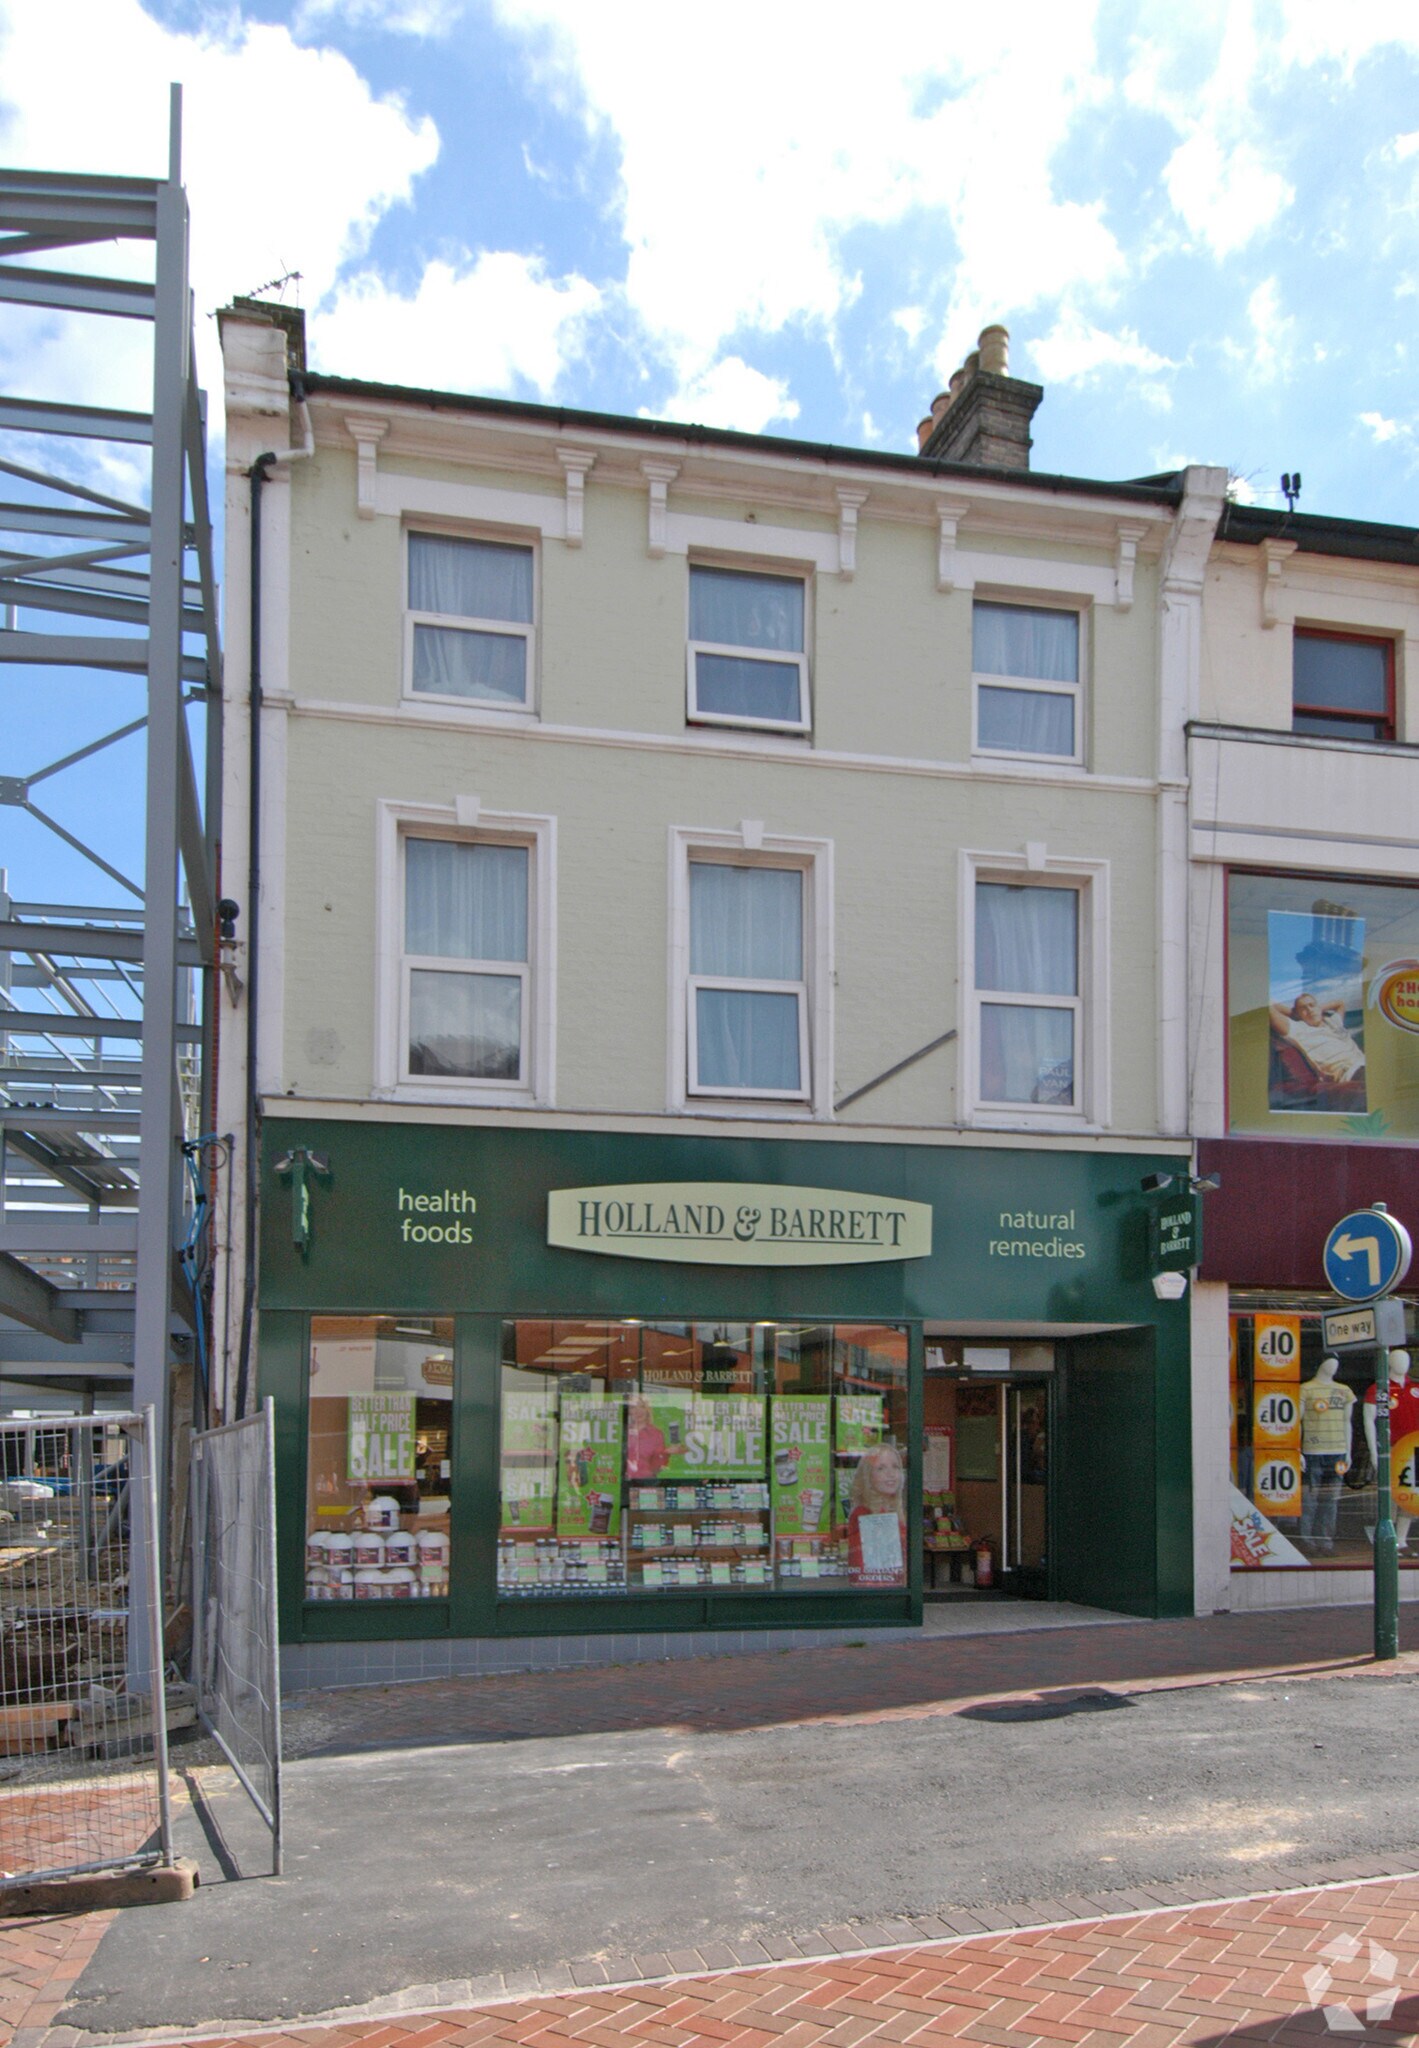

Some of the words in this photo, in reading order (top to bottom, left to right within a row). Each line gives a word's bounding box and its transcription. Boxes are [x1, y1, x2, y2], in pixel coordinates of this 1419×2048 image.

[398, 1187, 476, 1213] health
[577, 1200, 725, 1237] HOLLAND
[733, 1206, 762, 1242] &
[770, 1207, 907, 1246] BARRETT
[1000, 1209, 1075, 1230] natural
[1160, 1211, 1192, 1231] HOLLAND
[401, 1218, 473, 1244] foods
[1171, 1226, 1180, 1239] &
[989, 1236, 1086, 1258] remedies
[1160, 1236, 1191, 1255] BARRETT
[1328, 1322, 1349, 1337] One
[1351, 1319, 1372, 1335] way
[1260, 1331, 1294, 1356] £10
[643, 1369, 693, 1383] HOLLAND
[693, 1370, 704, 1384] &
[705, 1369, 753, 1384] BARRETT
[352, 1395, 385, 1411] BETTER
[506, 1406, 549, 1420] SALE
[1260, 1398, 1294, 1423] £10
[352, 1413, 378, 1432] HALF
[380, 1413, 411, 1432] PRICE
[562, 1421, 619, 1443] SALE
[685, 1415, 720, 1431] HALF
[722, 1415, 762, 1431] PRICE
[774, 1421, 827, 1443] SALE
[351, 1432, 411, 1477] SALE
[684, 1431, 762, 1465] SALE
[1260, 1466, 1295, 1491] £10
[506, 1482, 549, 1498] SALE
[1233, 1518, 1270, 1558] SALE
